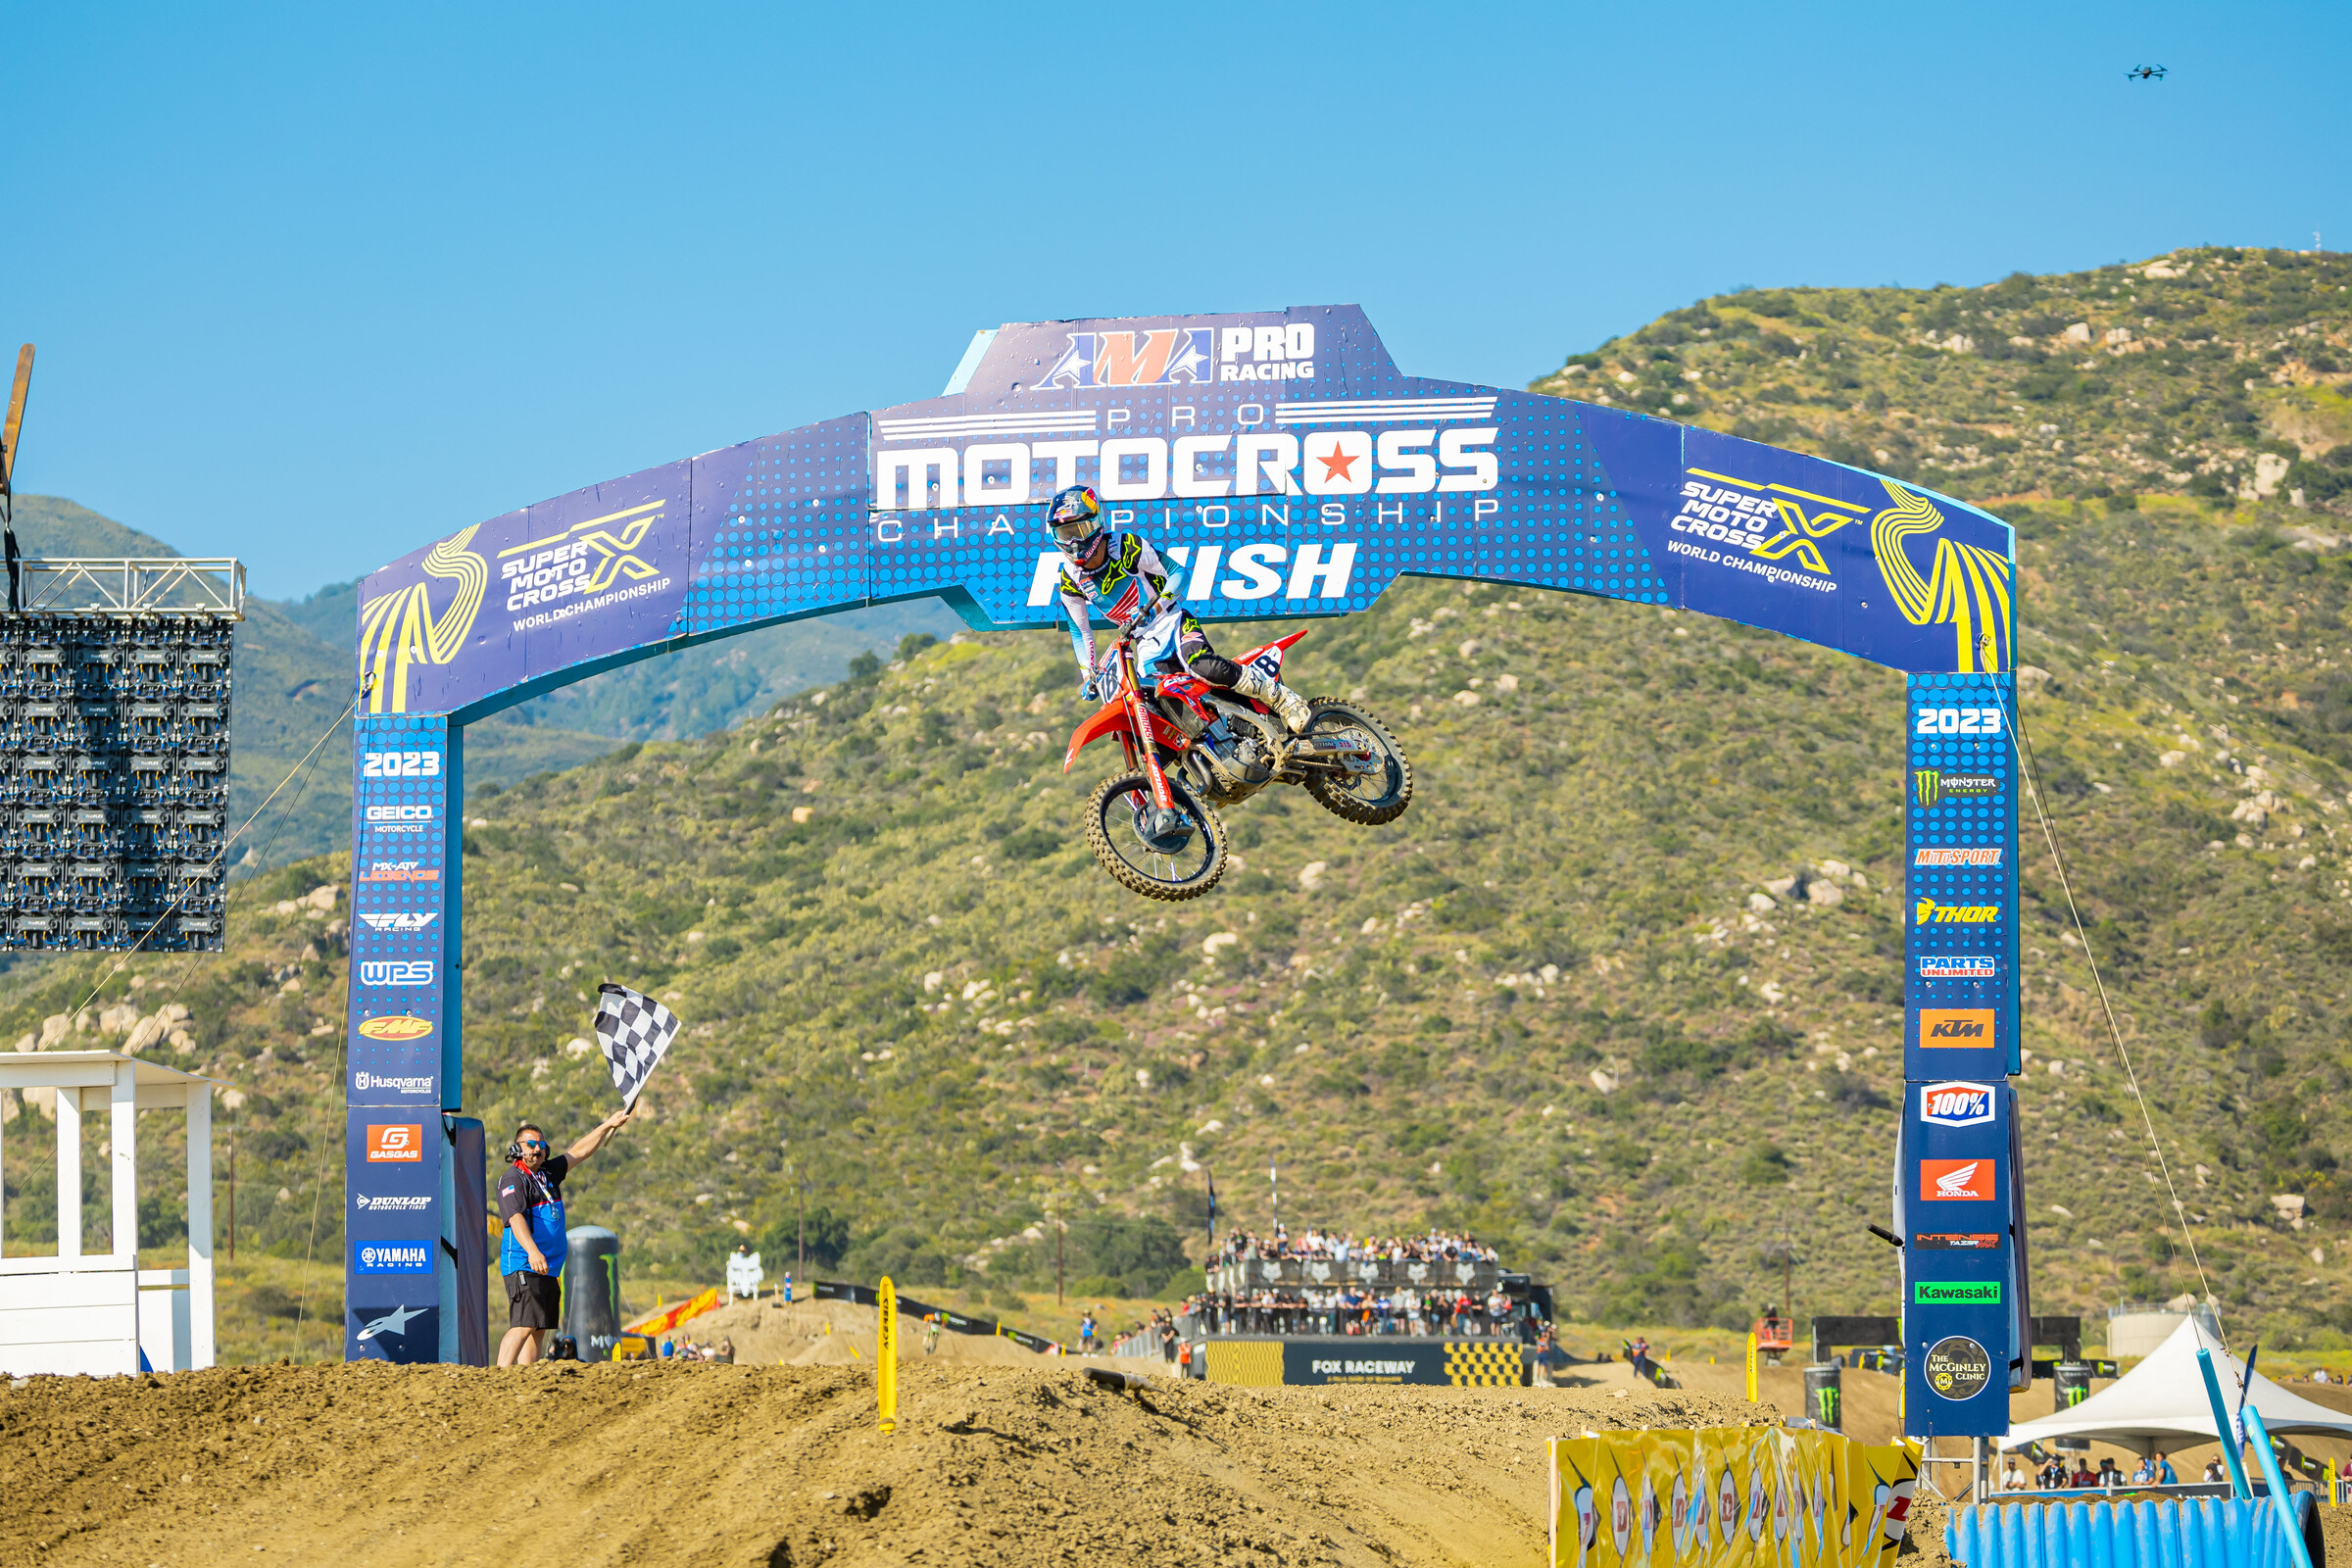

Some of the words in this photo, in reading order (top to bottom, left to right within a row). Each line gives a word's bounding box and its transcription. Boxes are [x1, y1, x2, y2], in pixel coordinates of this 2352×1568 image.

[1221, 322, 1315, 363] PRO
[1029, 327, 1214, 390] AMA
[1220, 361, 1314, 381] RACING
[1107, 403, 1264, 430] PRO
[877, 427, 1499, 510] MOTOCROSS
[1680, 480, 1778, 517] SUPER
[878, 499, 1498, 542] CHAPIONSHIP
[1681, 499, 1768, 533] MOTO
[1671, 514, 1765, 550] CROSS
[501, 541, 588, 579] SUPER
[1667, 540, 1721, 563] WORLD
[1722, 555, 1838, 593] CHAMPIONSHIP
[510, 558, 586, 594] MOTO
[1027, 543, 1357, 607] FISH
[507, 573, 590, 612] CROSS
[514, 609, 564, 631] WORLD
[564, 577, 670, 617] CHAMPIONSHIP
[1102, 662, 1118, 704] 18
[1139, 708, 1152, 738] SHOWA
[1917, 708, 2001, 734] 2023
[364, 752, 440, 776] 2023
[1940, 776, 1996, 788] MONSTER
[367, 806, 432, 820] GEICO
[359, 870, 439, 882] LEGENDS
[372, 861, 419, 871] MX-ATV
[372, 913, 438, 927] FLY
[1935, 906, 1999, 922] THOR
[363, 962, 433, 984] WPS
[1922, 957, 1993, 968] PARTS
[360, 1019, 432, 1035] FMF
[1930, 1019, 1984, 1037] KTM
[370, 1076, 432, 1090] Husqvarna
[1931, 1092, 1985, 1116] 100%
[370, 1197, 432, 1205] DUNLOP
[376, 1248, 426, 1262] YAMAHA
[1919, 1286, 1998, 1298] Kawasaki
[1312, 1360, 1342, 1374] FOX
[1345, 1360, 1416, 1374] RACEWAY
[1955, 1372, 1985, 1381] CLINIC
